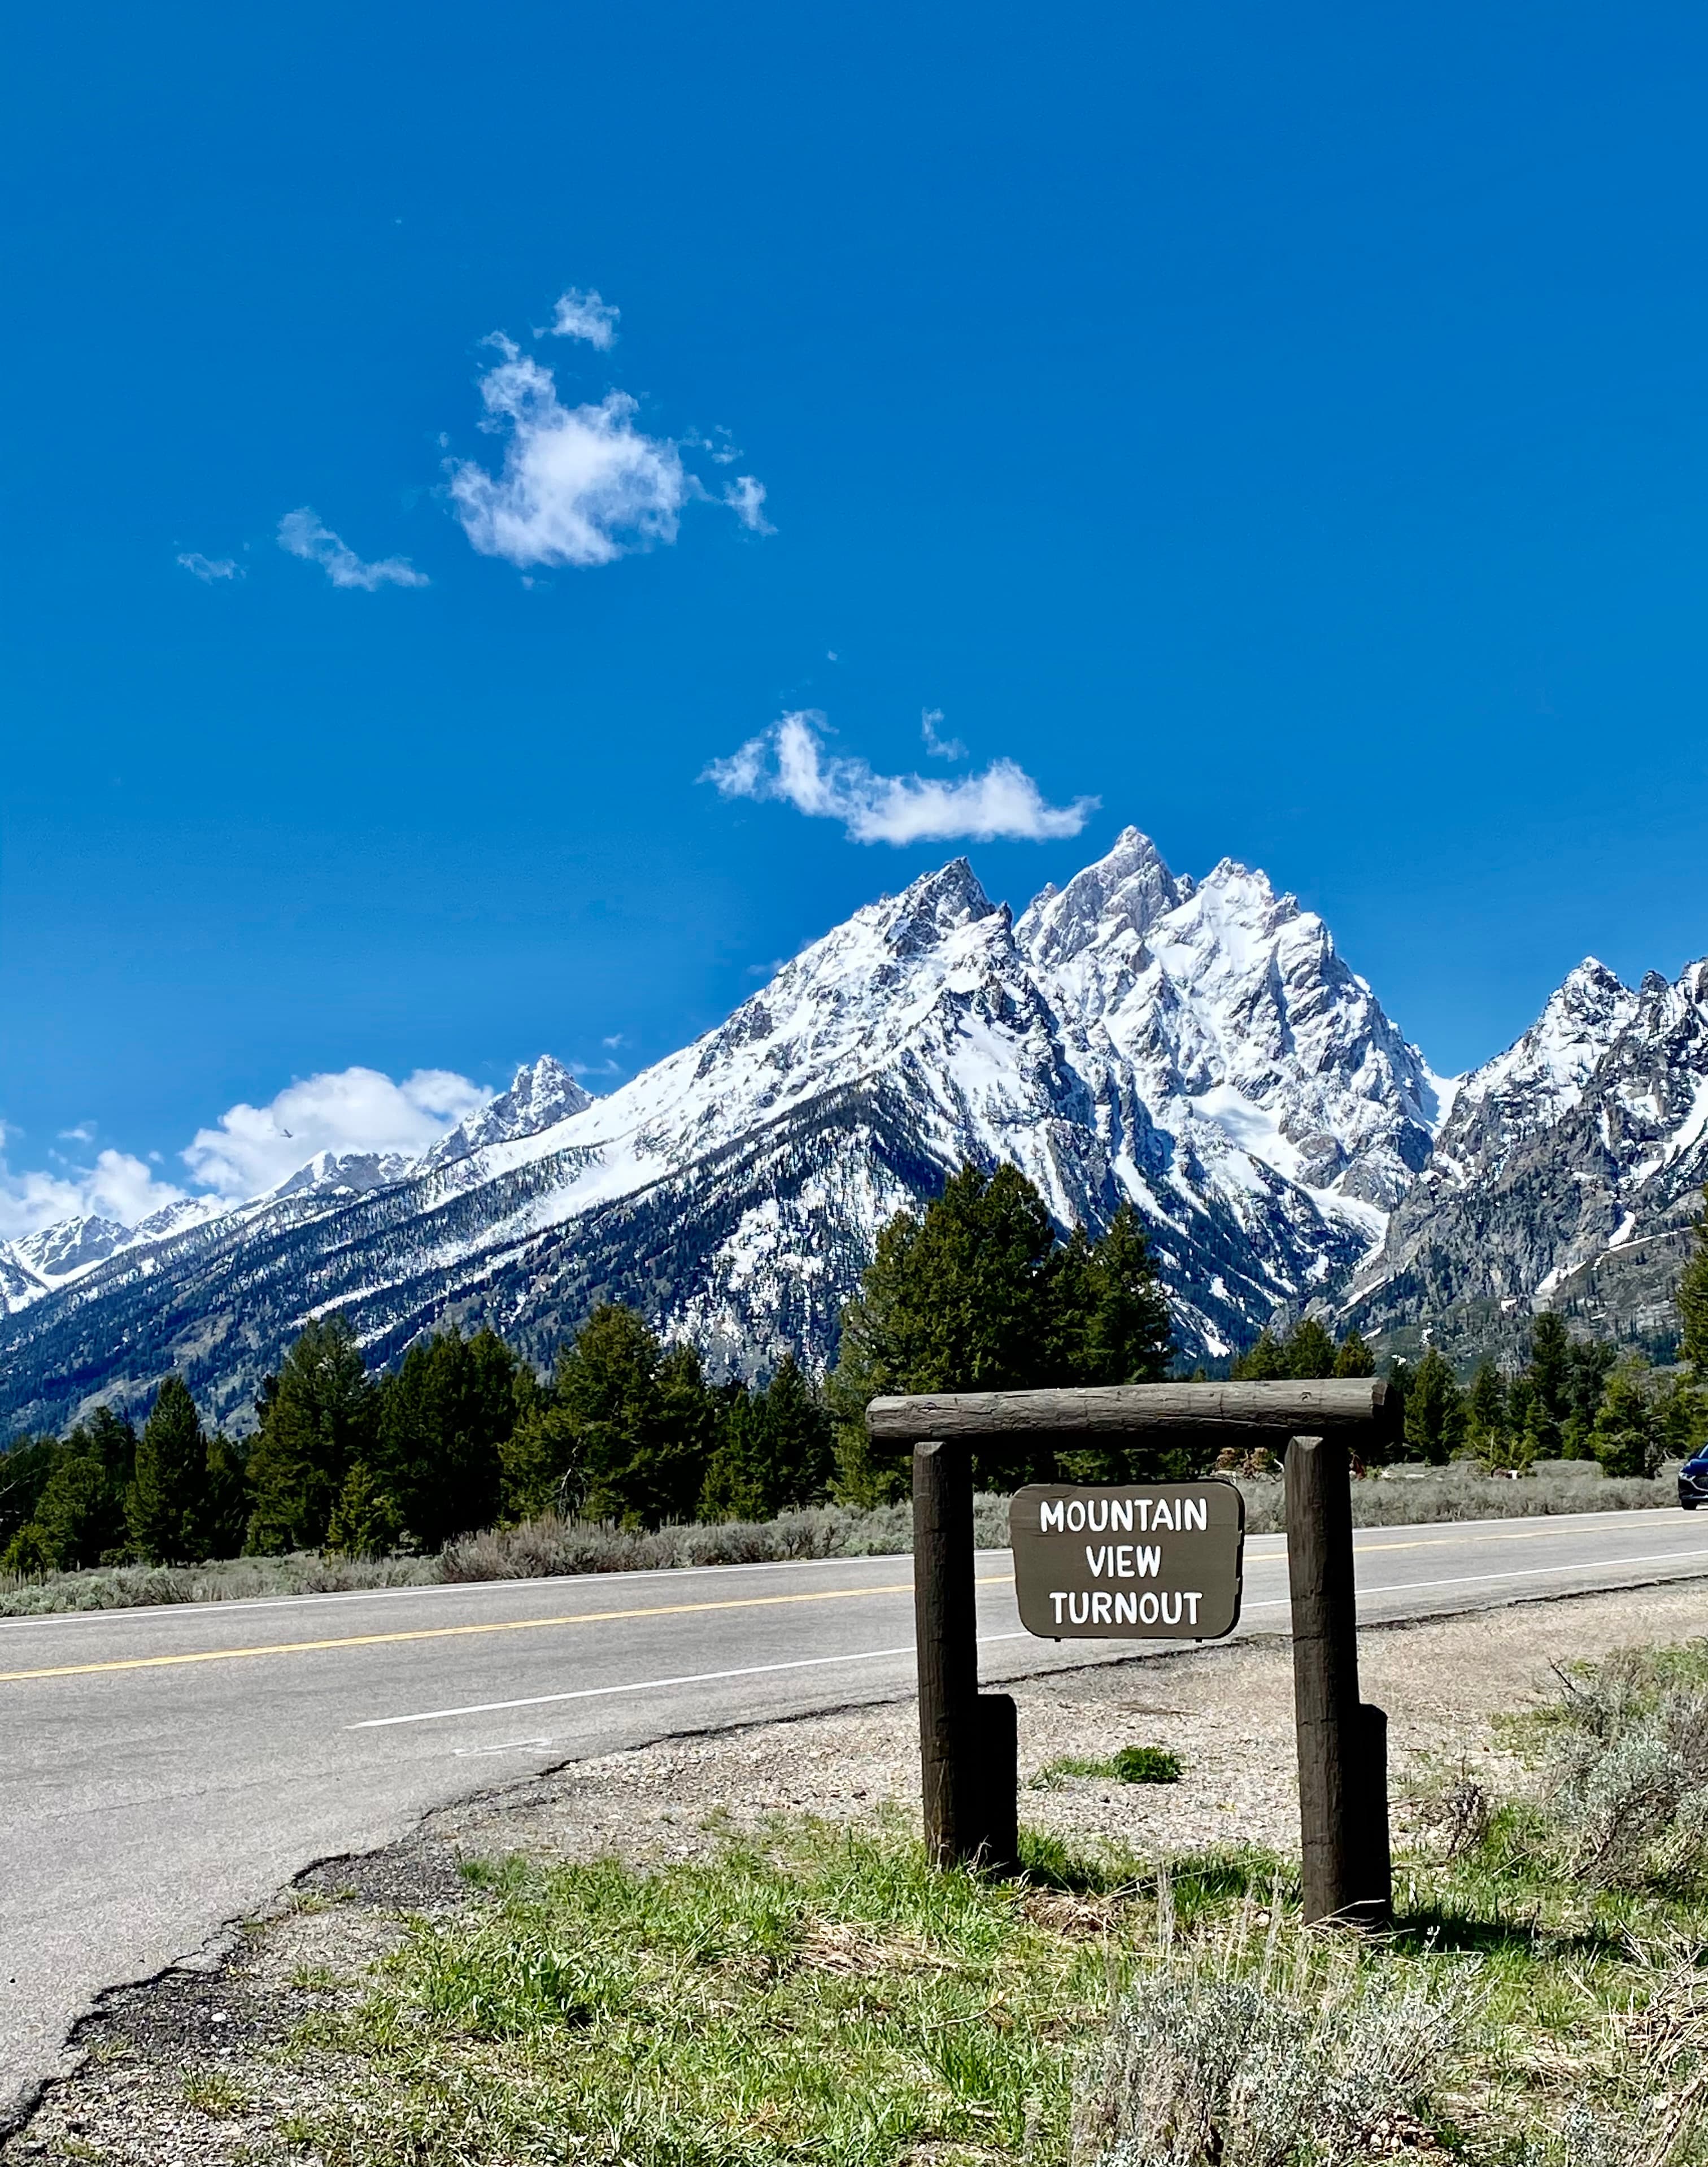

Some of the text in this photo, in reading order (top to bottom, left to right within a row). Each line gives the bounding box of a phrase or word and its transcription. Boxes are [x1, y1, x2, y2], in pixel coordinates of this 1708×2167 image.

[1040, 1498, 1207, 1532] MOUNTAIN
[1086, 1545, 1161, 1577] VIEW
[1049, 1591, 1203, 1625] TURNOUT
